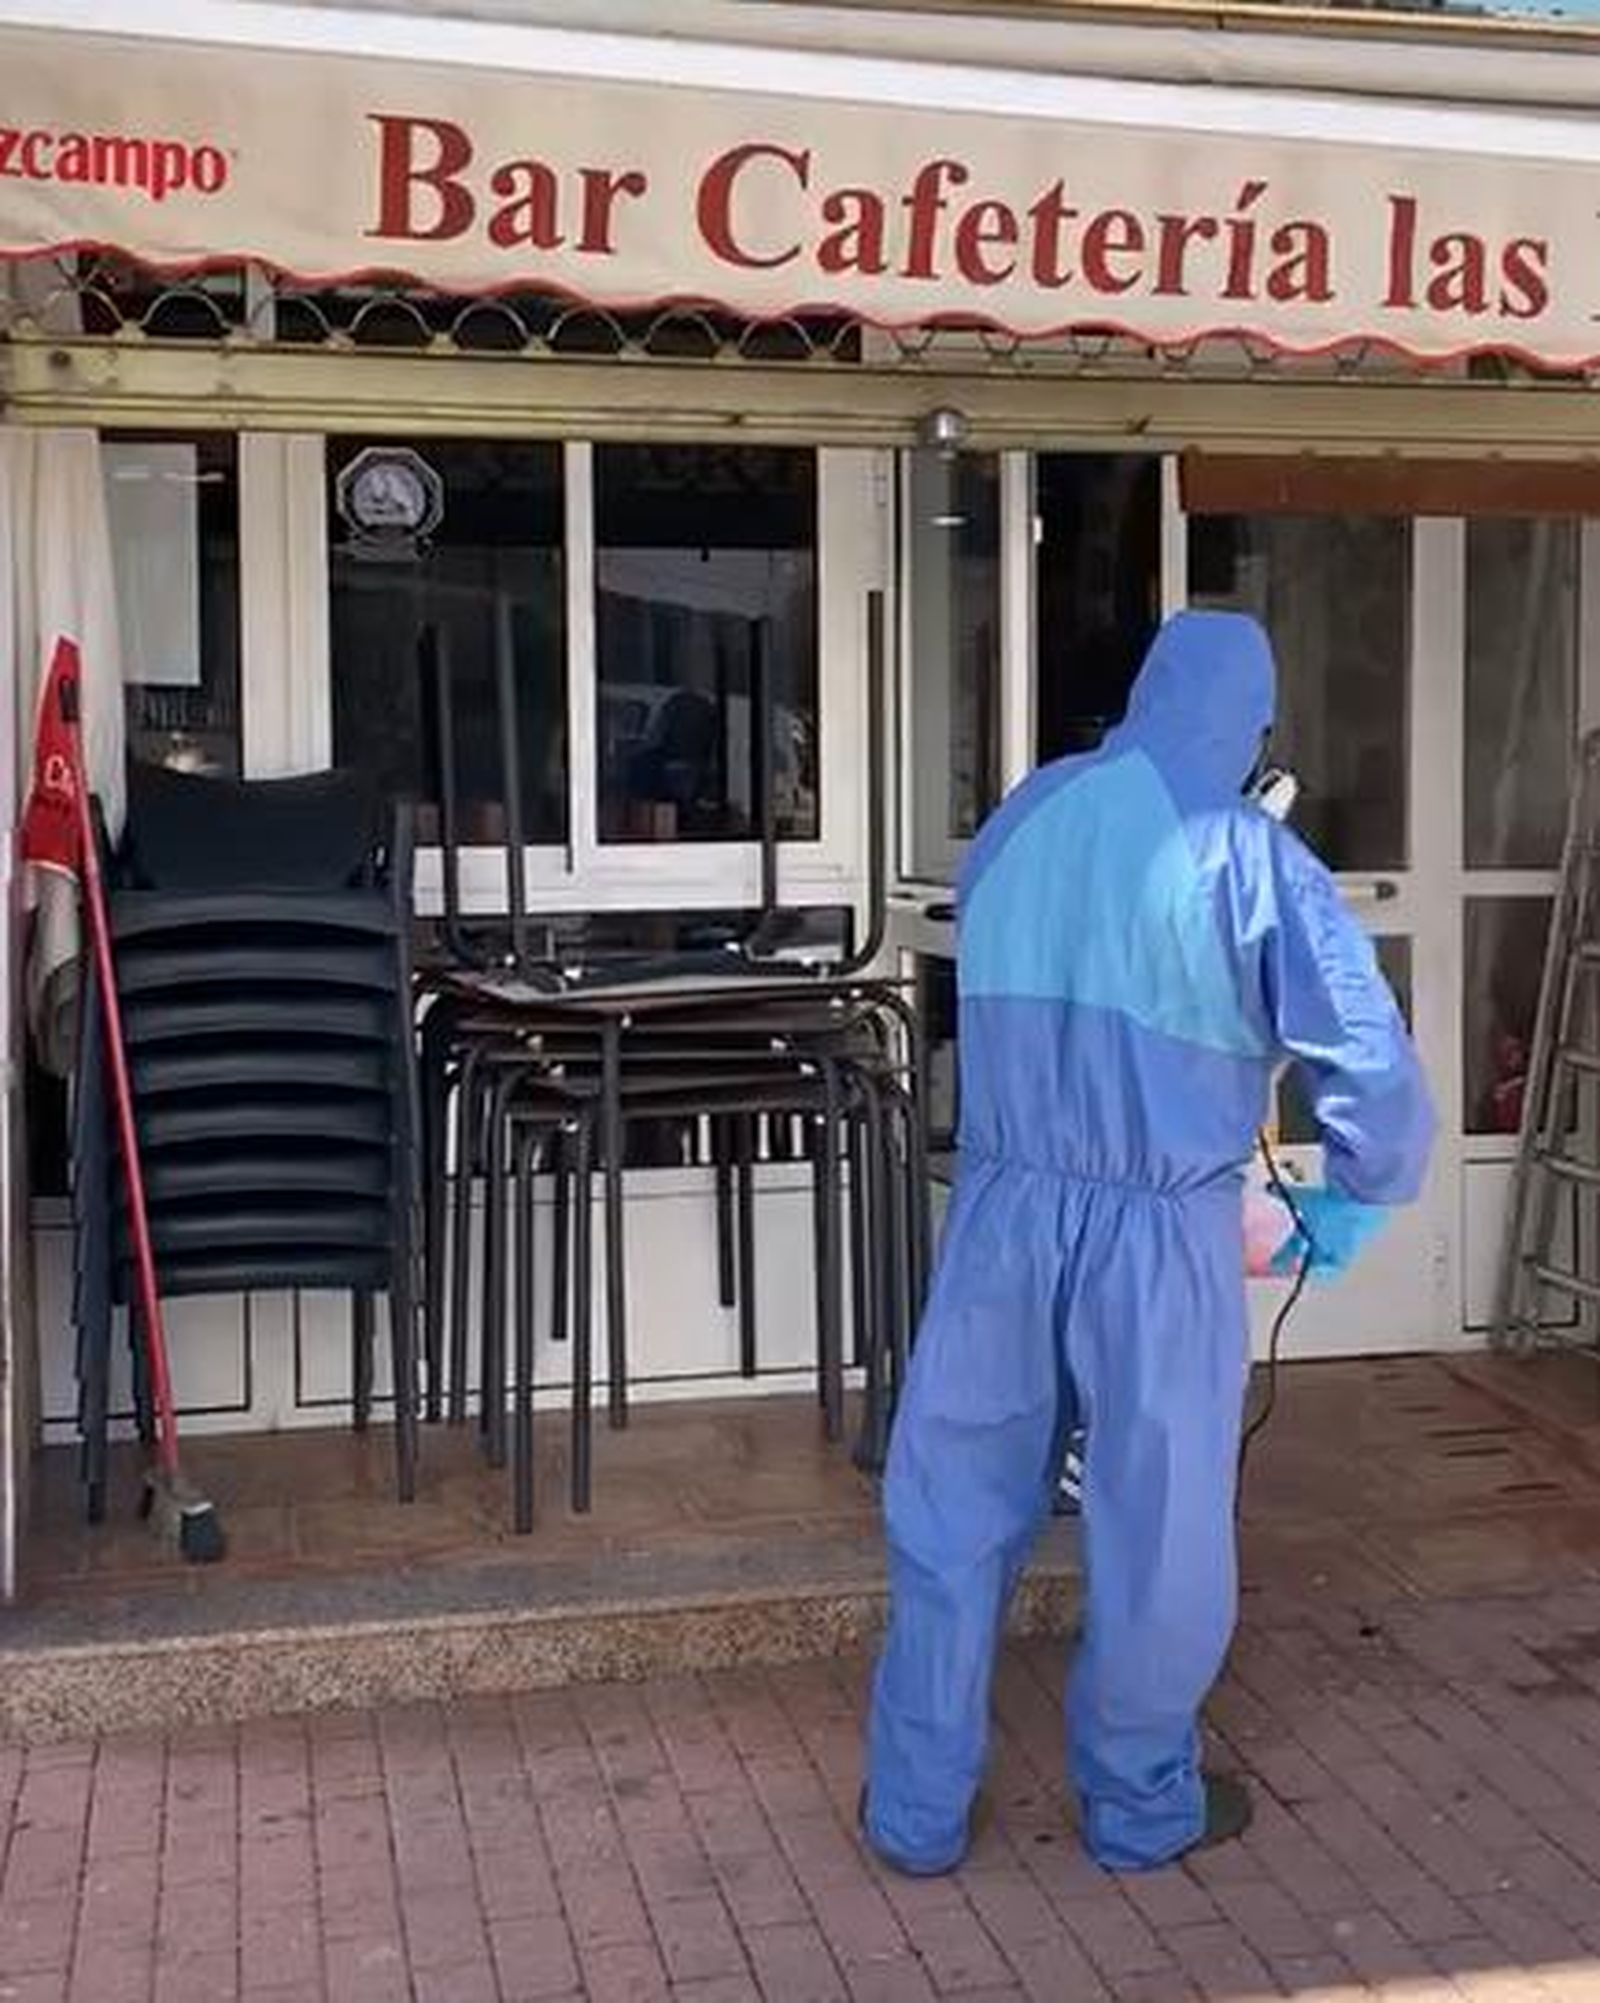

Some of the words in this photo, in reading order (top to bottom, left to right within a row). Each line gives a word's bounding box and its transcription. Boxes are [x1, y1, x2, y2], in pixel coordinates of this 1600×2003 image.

[365, 112, 647, 255] Bar
[695, 143, 1335, 305] Cafetería
[1382, 194, 1549, 319] las
